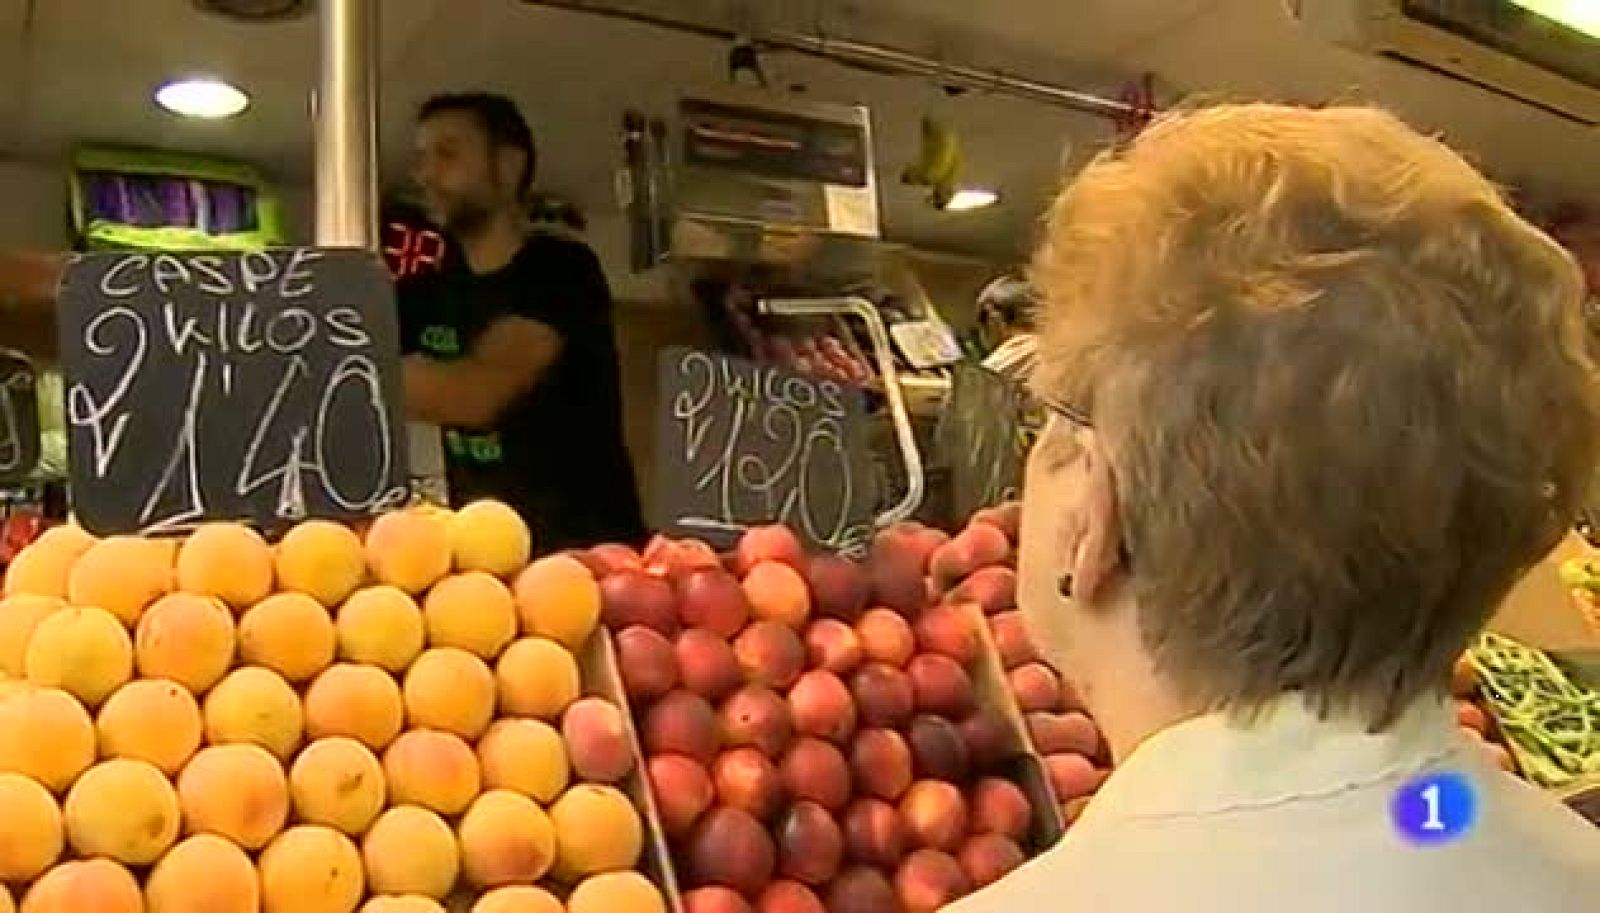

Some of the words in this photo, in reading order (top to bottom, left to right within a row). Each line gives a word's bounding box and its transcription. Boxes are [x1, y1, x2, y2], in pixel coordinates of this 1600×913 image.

[100, 249, 325, 298] CASPE
[69, 306, 148, 479] 2
[162, 301, 372, 355] KILOS
